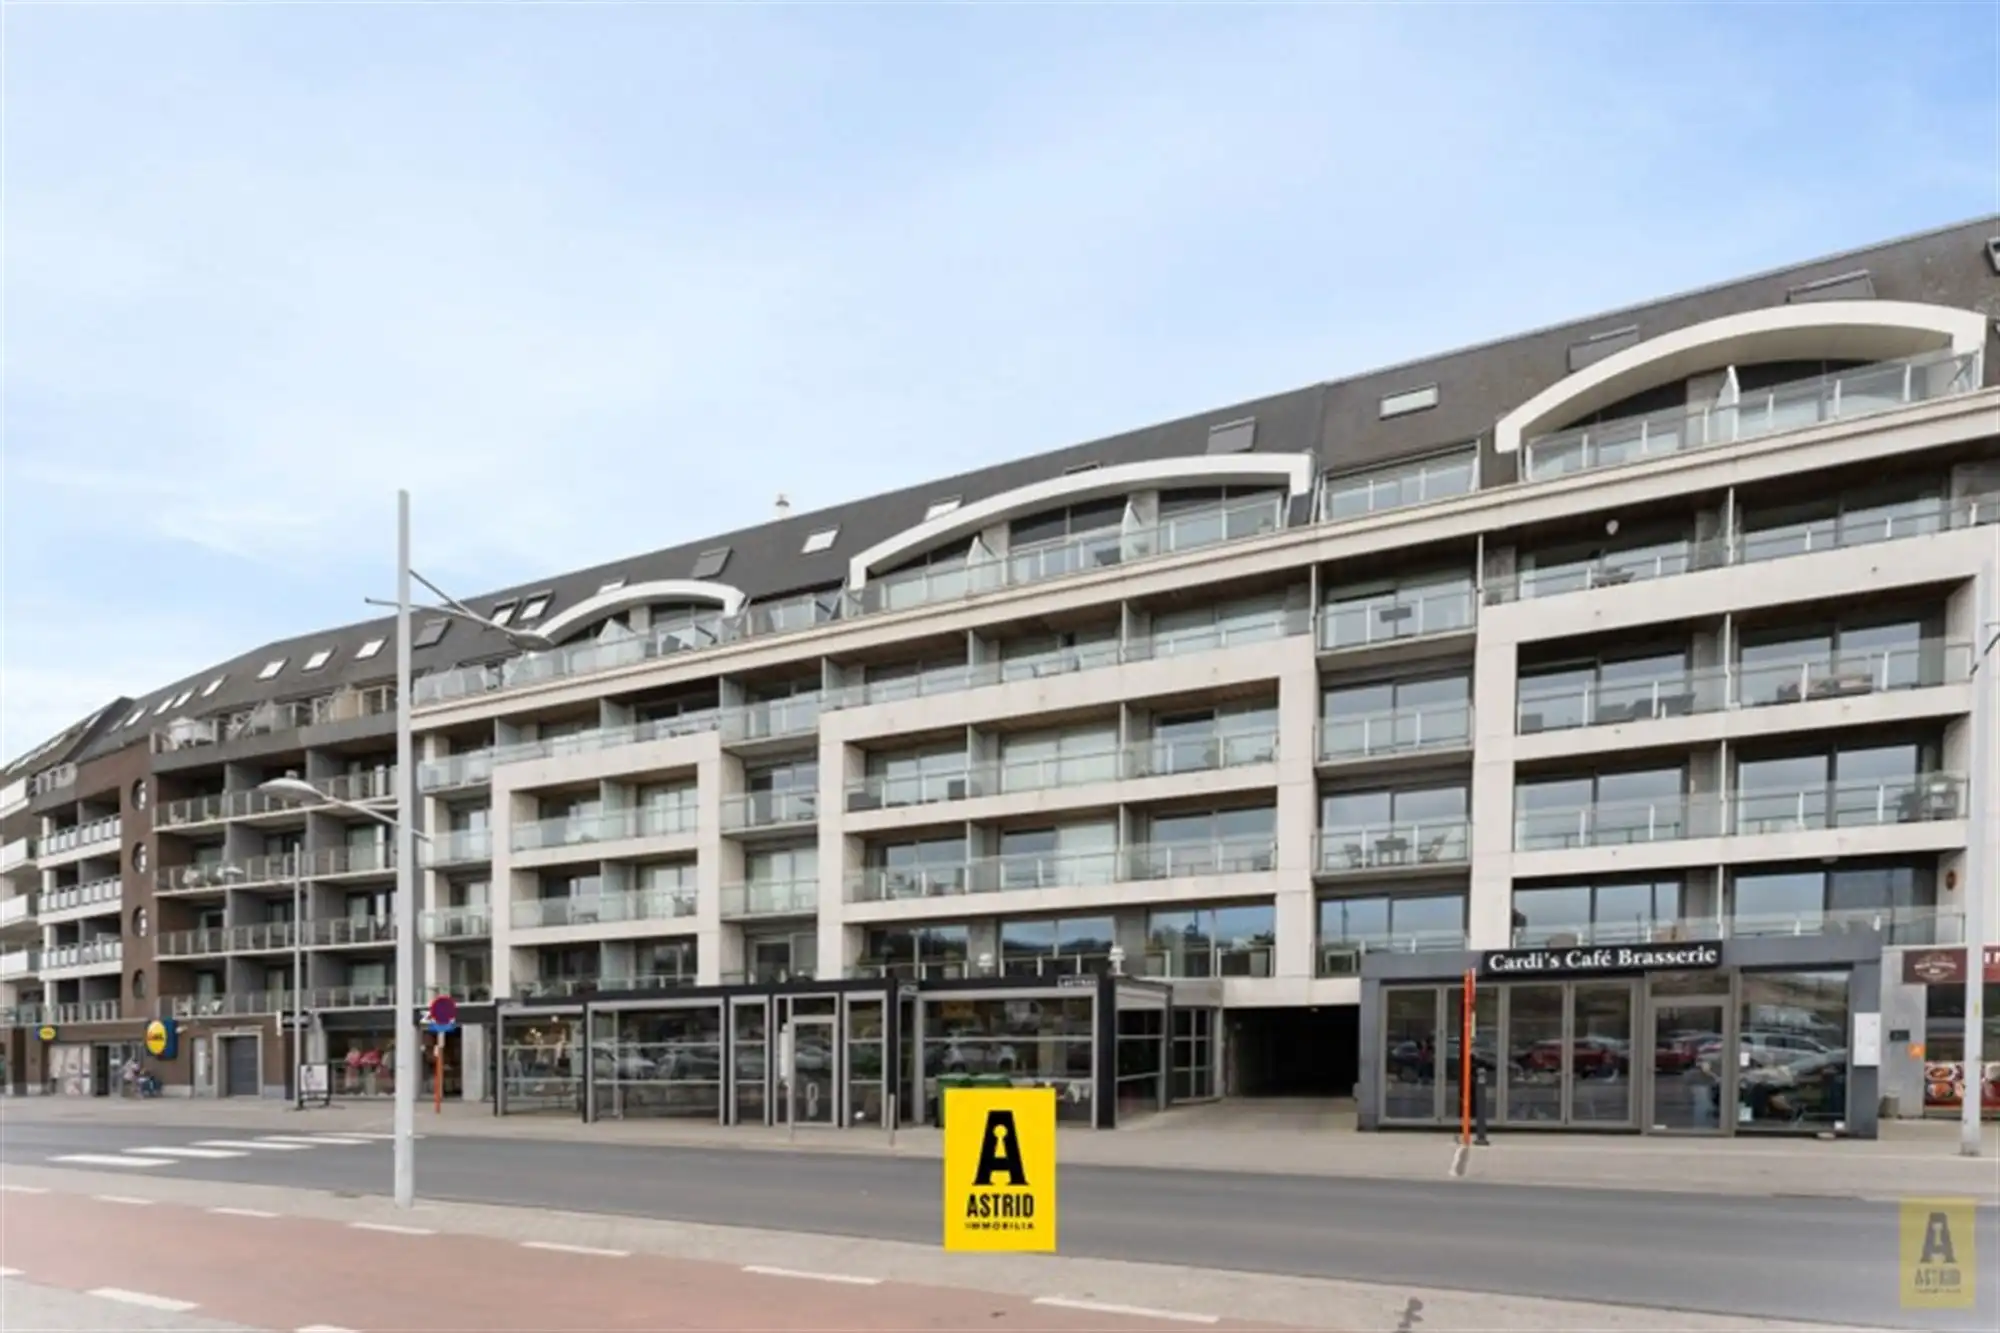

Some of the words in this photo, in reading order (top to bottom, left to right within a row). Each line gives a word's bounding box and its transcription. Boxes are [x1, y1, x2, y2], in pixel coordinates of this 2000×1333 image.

[1488, 953, 1560, 971] Cardi's
[1565, 949, 1611, 968] Café
[1618, 945, 1717, 966] Brasserie
